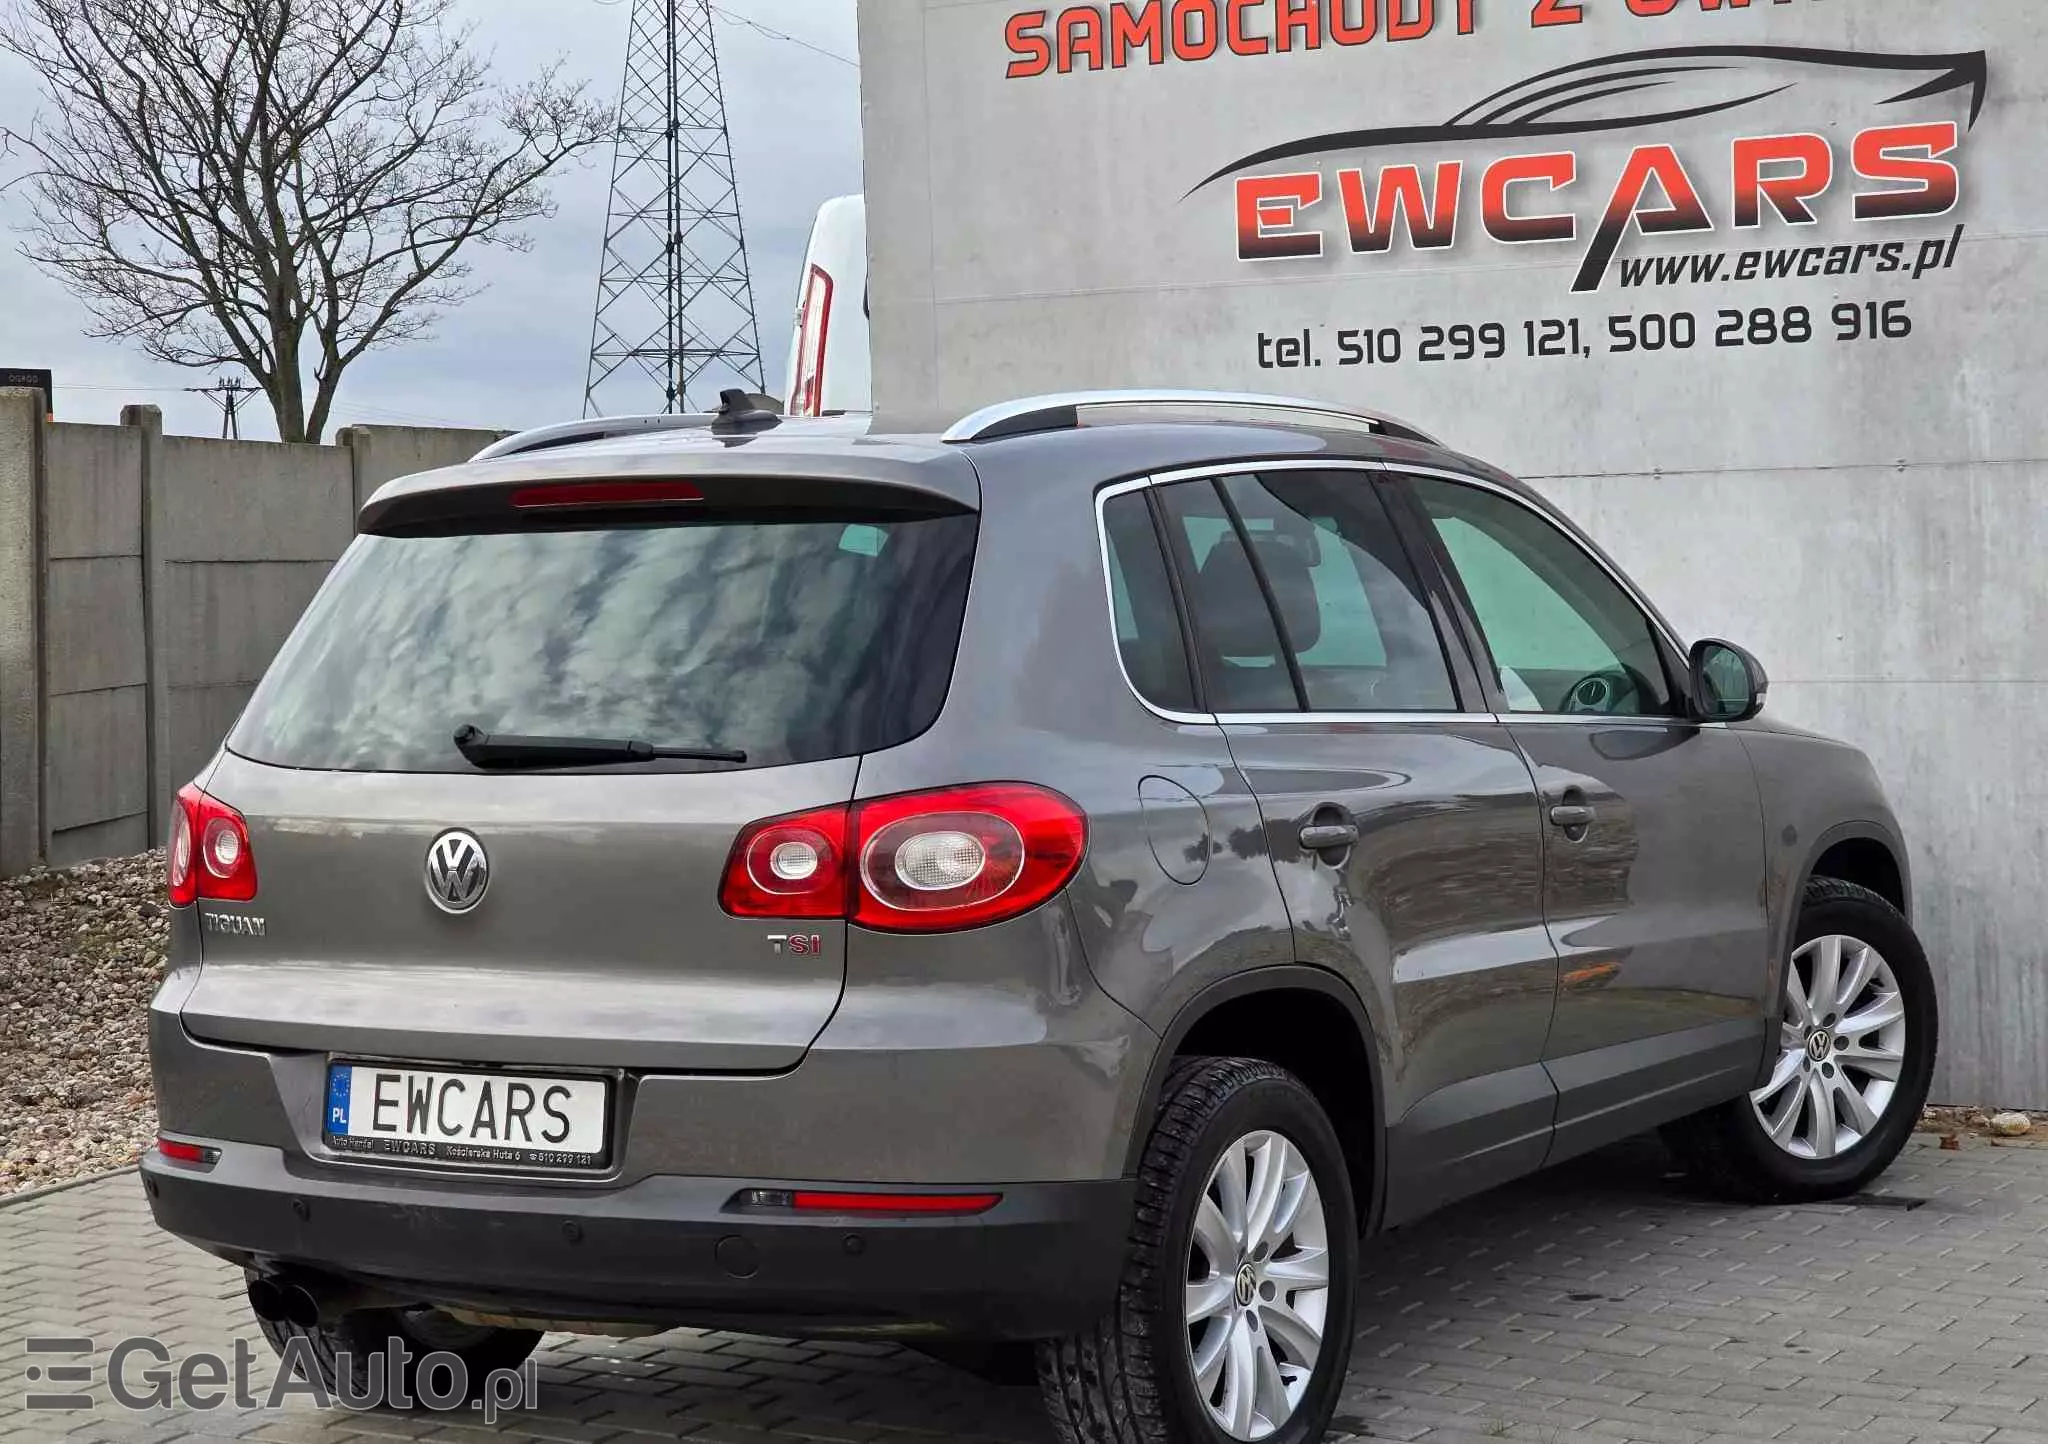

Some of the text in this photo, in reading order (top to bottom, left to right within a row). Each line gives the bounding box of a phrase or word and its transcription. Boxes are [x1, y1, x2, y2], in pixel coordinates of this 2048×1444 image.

[1235, 121, 1960, 293] EWCARS
[1620, 224, 1965, 287] www.ewcars.pl
[1257, 300, 1912, 368] tel. 510 299 121, 500 288 916
[205, 912, 266, 936] TIGUAN
[767, 934, 820, 954] TSI
[332, 1107, 347, 1124] PL
[372, 1073, 572, 1143] EWCARS
[384, 1139, 436, 1155] EWCARS
